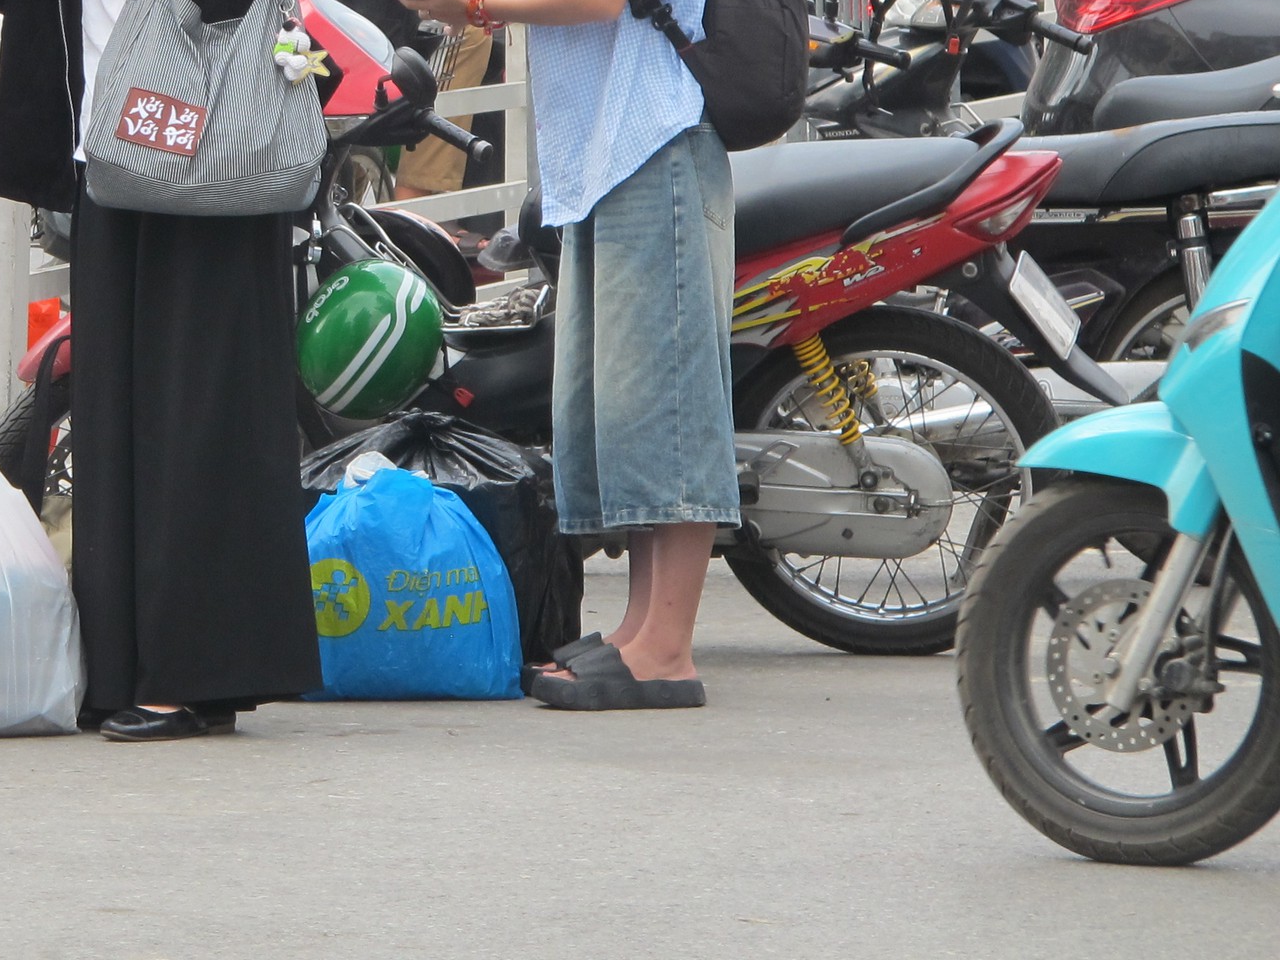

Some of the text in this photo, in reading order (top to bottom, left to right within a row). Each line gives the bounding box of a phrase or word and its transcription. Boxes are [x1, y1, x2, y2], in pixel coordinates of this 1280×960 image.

[129, 96, 199, 127] Xởi Lởi
[824, 128, 860, 138] HONDA
[305, 276, 350, 323] Grab
[385, 568, 441, 598] Điện
